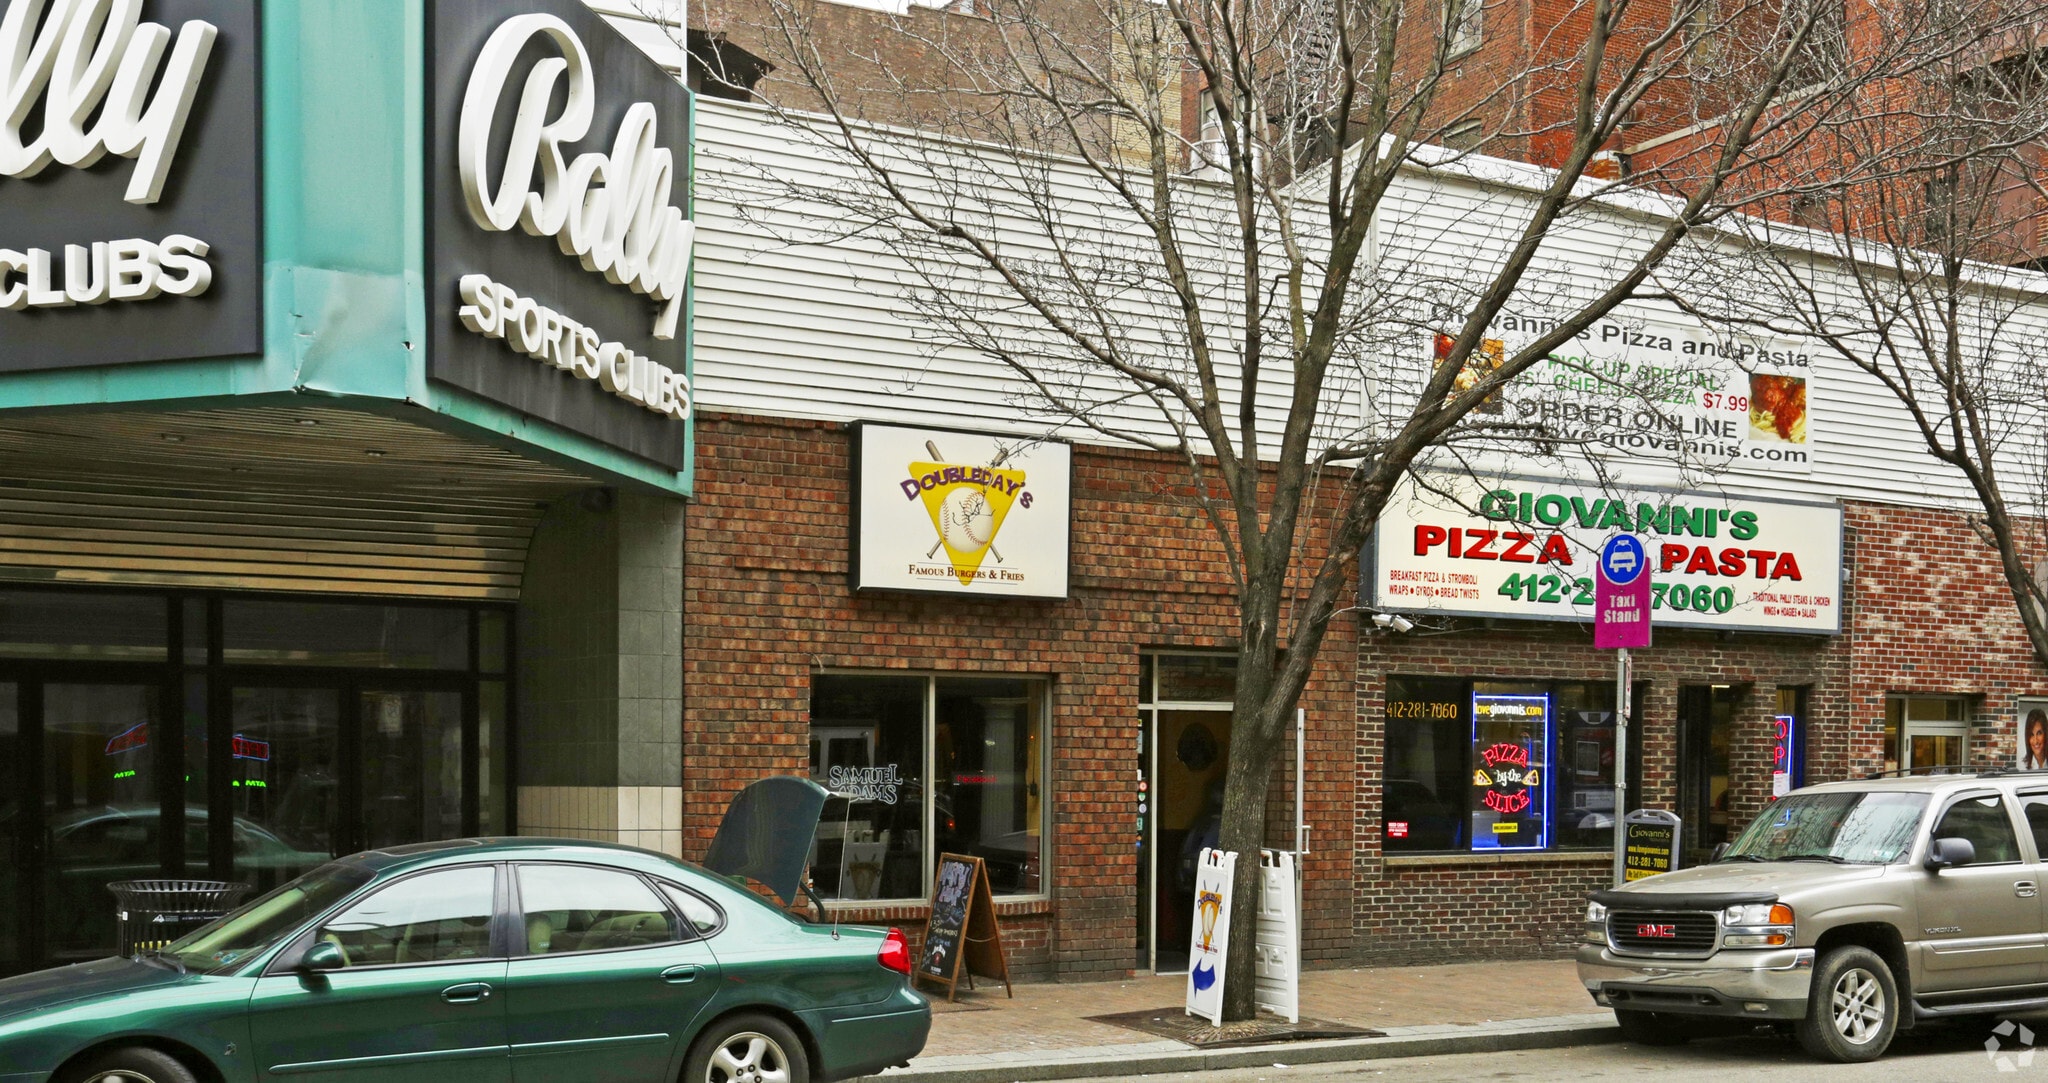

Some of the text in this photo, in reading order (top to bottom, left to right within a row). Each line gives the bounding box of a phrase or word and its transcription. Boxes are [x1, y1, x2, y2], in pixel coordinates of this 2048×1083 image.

[459, 13, 694, 340] Bally
[0, 234, 212, 311] CLUBS
[458, 274, 691, 421] SPORTS CLUBS
[1602, 323, 1673, 352] Pizza
[1736, 343, 1808, 369] Pasta
[1702, 391, 1748, 412] $7.99
[1517, 397, 1738, 439] ORDER ONLINE
[1480, 489, 1760, 541] GIOVANNI'S
[1413, 524, 1803, 581] PIZZA PASTA
[988, 569, 998, 580] &
[1390, 569, 1479, 585] BREAKFAST PIZZA & STROMBOLI
[1389, 584, 1480, 600] WRAPS GYROS BREAD TWISTS
[1609, 594, 1636, 607] Taxi
[1603, 608, 1640, 624] Stand
[1802, 608, 1817, 619] SALADS
[1386, 701, 1458, 719] 412-281-7060
[1483, 742, 1529, 768] PIZZA
[829, 763, 903, 787] SAMUEL
[838, 784, 897, 804] ADAMS
[1485, 788, 1531, 813] SLICE
[1636, 924, 1676, 938] GMC
